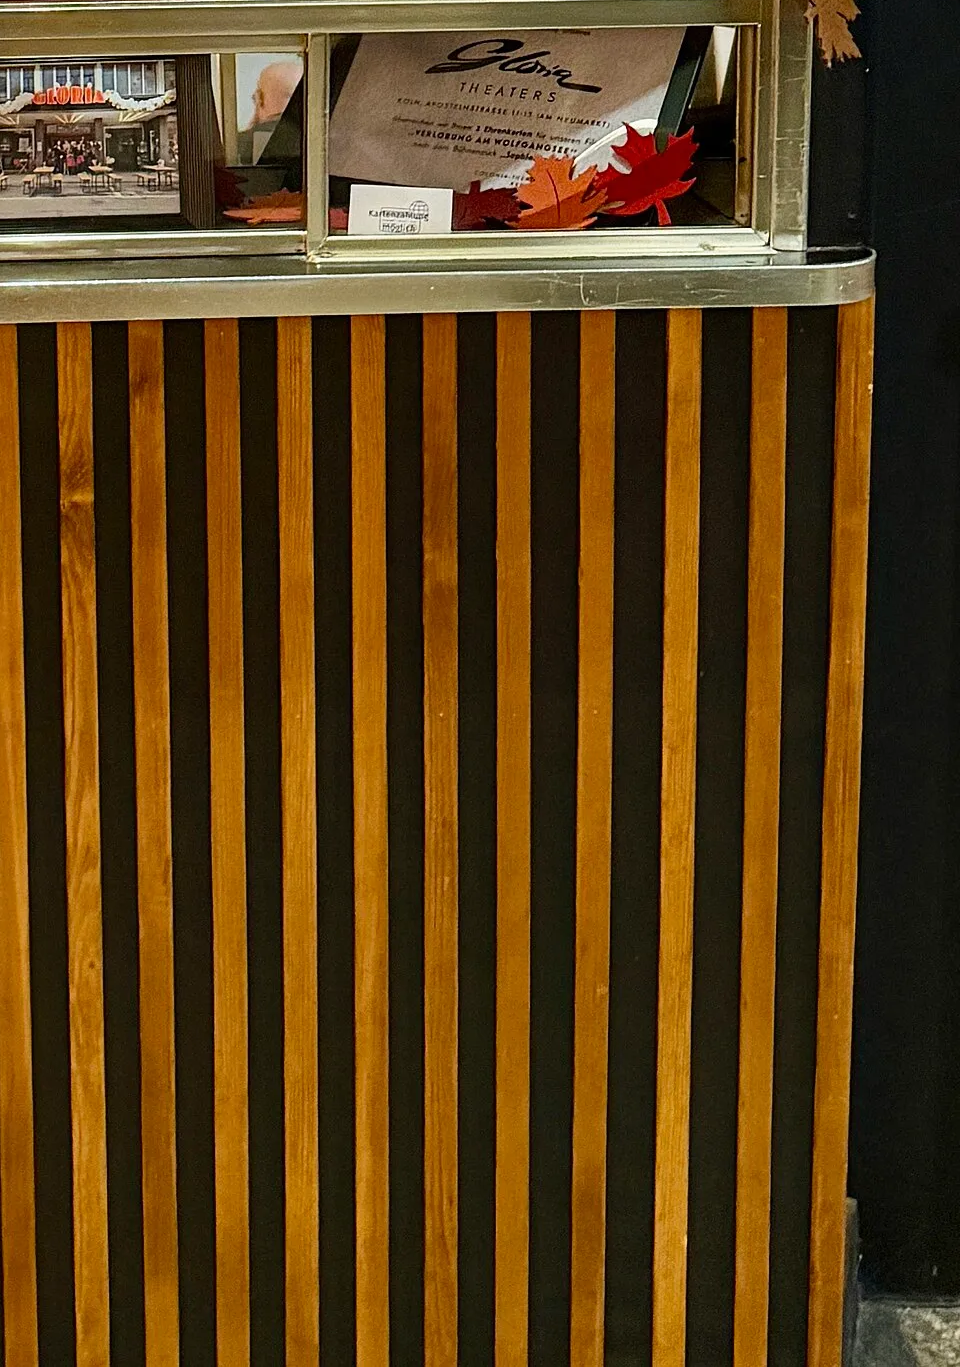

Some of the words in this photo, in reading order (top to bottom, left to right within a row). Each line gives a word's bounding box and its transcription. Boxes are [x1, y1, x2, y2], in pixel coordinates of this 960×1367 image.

[425, 38, 603, 94] Gloria
[32, 85, 106, 106] GLORIA
[459, 81, 558, 103] THEATERS
[368, 209, 430, 222] Kartenzahlung
